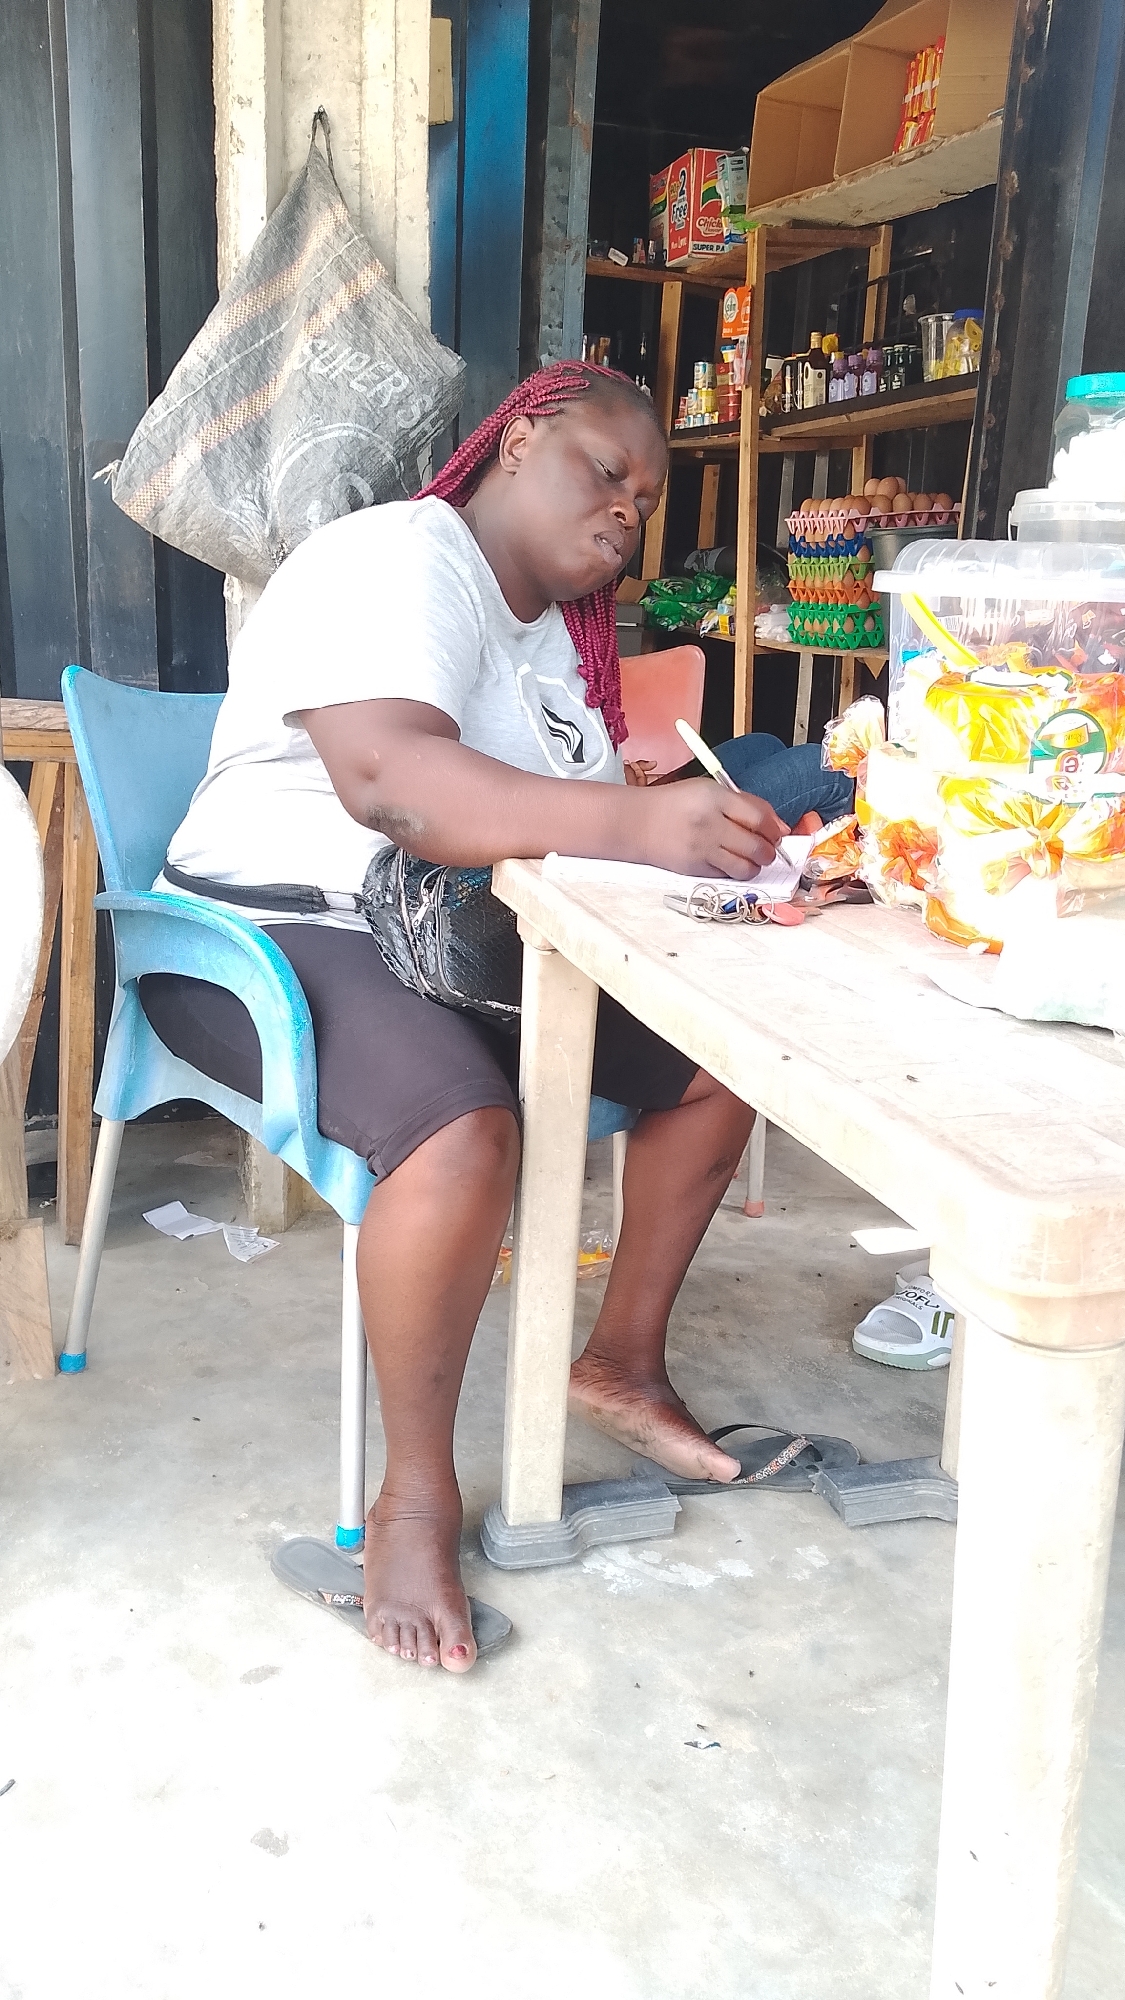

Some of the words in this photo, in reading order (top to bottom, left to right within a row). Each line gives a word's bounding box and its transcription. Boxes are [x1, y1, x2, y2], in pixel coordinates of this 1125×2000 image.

[671, 202, 688, 222] Free
[692, 243, 714, 252] SUPER
[294, 339, 410, 408] SUPER
